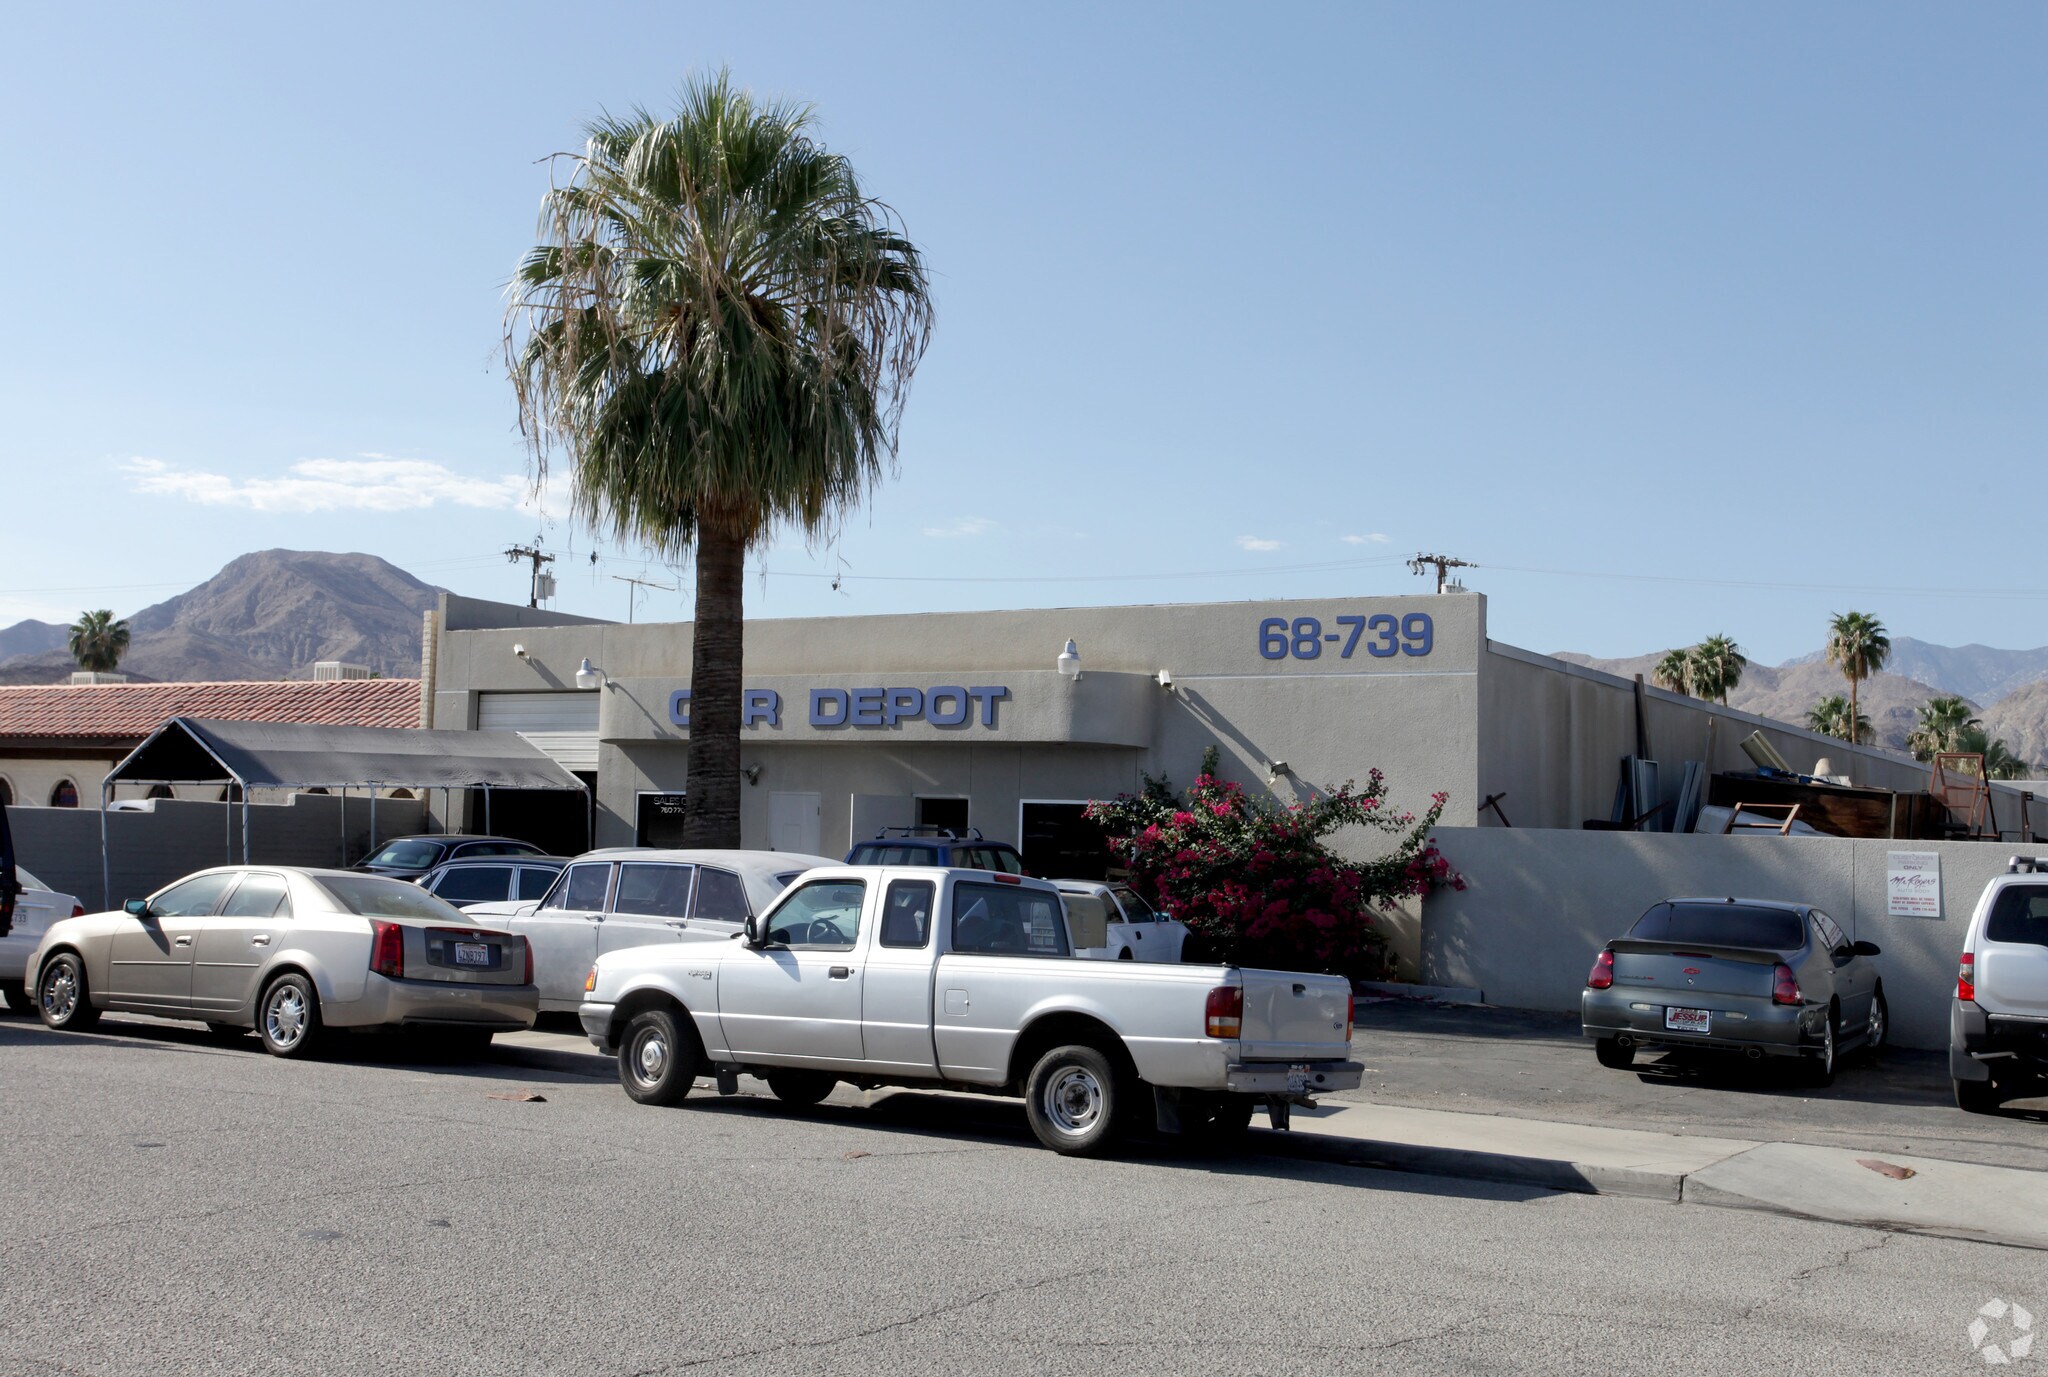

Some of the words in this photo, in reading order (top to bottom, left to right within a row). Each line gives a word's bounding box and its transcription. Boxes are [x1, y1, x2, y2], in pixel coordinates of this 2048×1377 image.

[1259, 612, 1433, 660] 68-739
[668, 688, 778, 726] CR
[809, 685, 1007, 726] DEPOT
[653, 796, 680, 806] SALES
[1668, 1012, 1708, 1023] JESSUP
